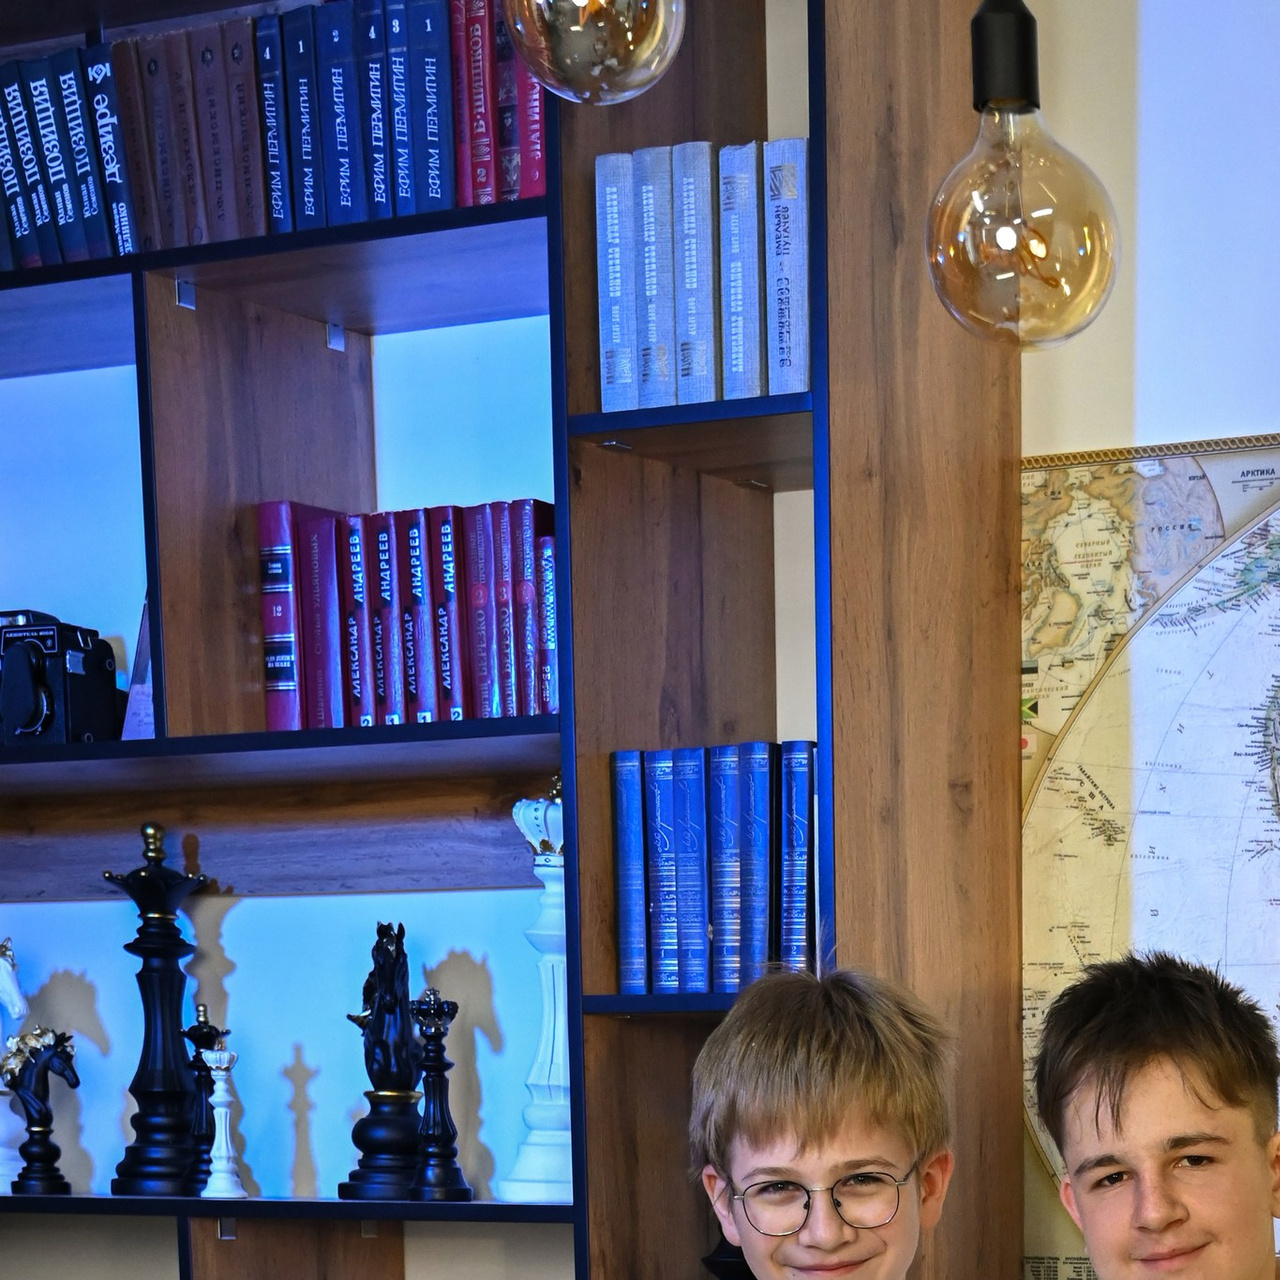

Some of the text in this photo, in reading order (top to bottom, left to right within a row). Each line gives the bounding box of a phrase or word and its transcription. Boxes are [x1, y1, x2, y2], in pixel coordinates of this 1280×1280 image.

[263, 47, 271, 59] 4
[298, 40, 304, 53] 1
[332, 30, 340, 42] 2
[368, 25, 376, 39] 4
[392, 19, 400, 33] 3
[425, 19, 432, 31] 1
[4, 83, 40, 185] ПОЗИЦИЯ
[30, 78, 66, 184] ПОЗИЦИЯ
[59, 71, 91, 176] ПОЗИЦИЯ
[263, 82, 284, 219] ЕФИМ ПЕРМИТИН
[299, 79, 315, 216] ЕФИМ ПЕРМИТИН
[331, 67, 352, 207] ЕФИМ ПЕРМИТИН
[369, 63, 386, 203] ЕФИМ ПЕРМИТИН
[392, 57, 411, 198] ЕФИМ ПЕРМИТИН
[425, 57, 442, 199] ЕФИМ ПЕРМИТИН
[1240, 467, 1276, 479] АРКТИКА
[349, 535, 365, 698] АЛЕКСАНДР АНДРЕЕВ
[374, 532, 391, 696] АЛЕКСАНДР АНДРЕЕВ
[404, 528, 423, 693] АЛЕКСАНДР АНДРЕЕВ
[438, 524, 455, 689] АЛЕКСАНДР АНДРЕЕВ
